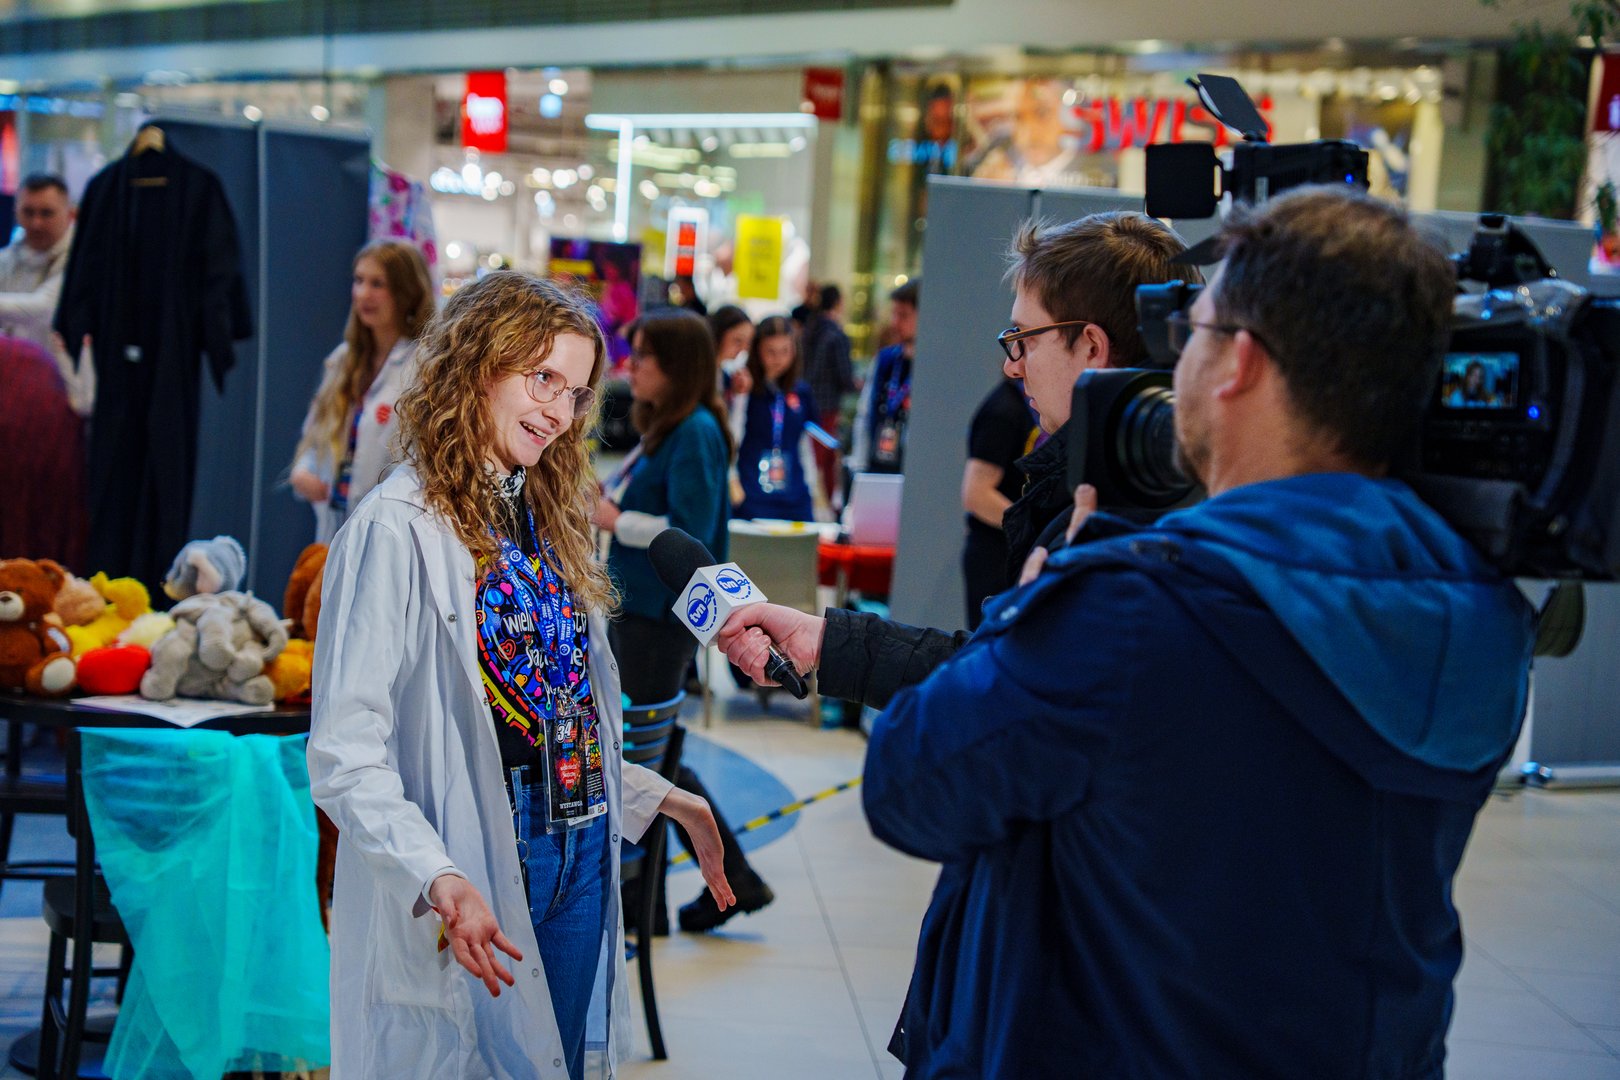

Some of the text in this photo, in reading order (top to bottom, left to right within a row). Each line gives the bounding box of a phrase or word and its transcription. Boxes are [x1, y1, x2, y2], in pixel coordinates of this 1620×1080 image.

[1067, 94, 1274, 153] SWIS
[721, 580, 738, 590] tvn
[523, 593, 533, 607] 112
[690, 590, 715, 623] tvn 24
[503, 611, 535, 634] wielk
[545, 623, 555, 638] 112
[556, 719, 574, 744] 34
